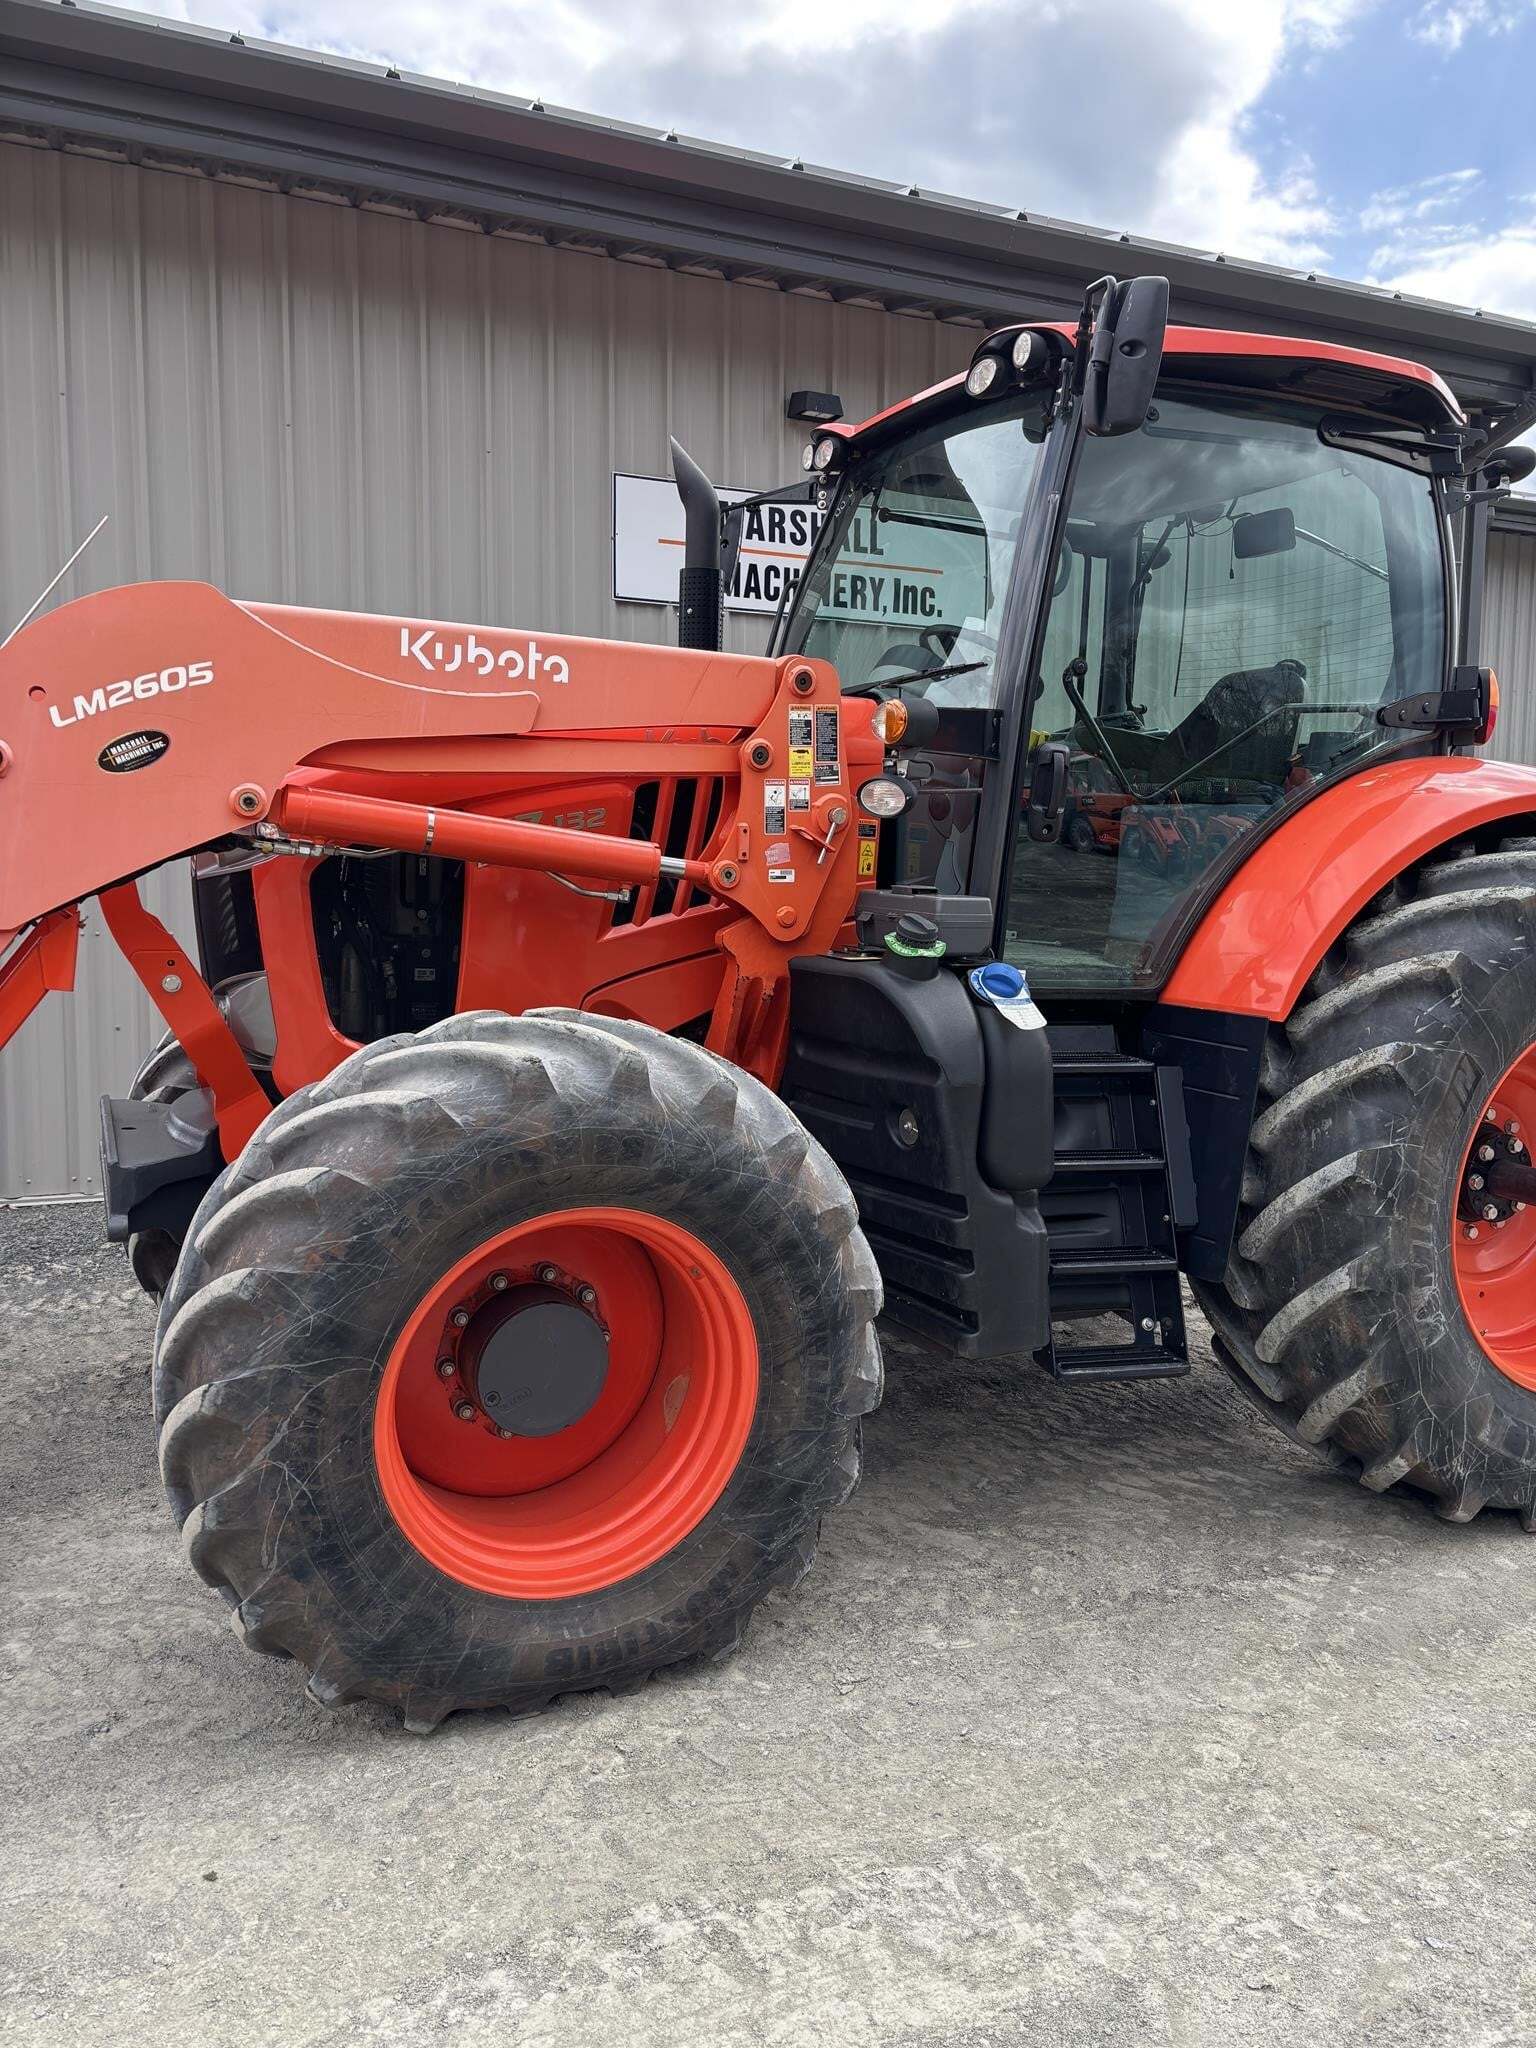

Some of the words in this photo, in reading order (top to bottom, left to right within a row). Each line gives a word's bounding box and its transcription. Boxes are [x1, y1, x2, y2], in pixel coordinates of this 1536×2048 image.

[719, 501, 884, 556] ARSHLL
[722, 562, 887, 616] ACHERY,
[893, 577, 943, 617] Inc.
[401, 628, 568, 683] Kubota
[49, 661, 214, 727] LM2605
[110, 735, 148, 755] MARSHALL
